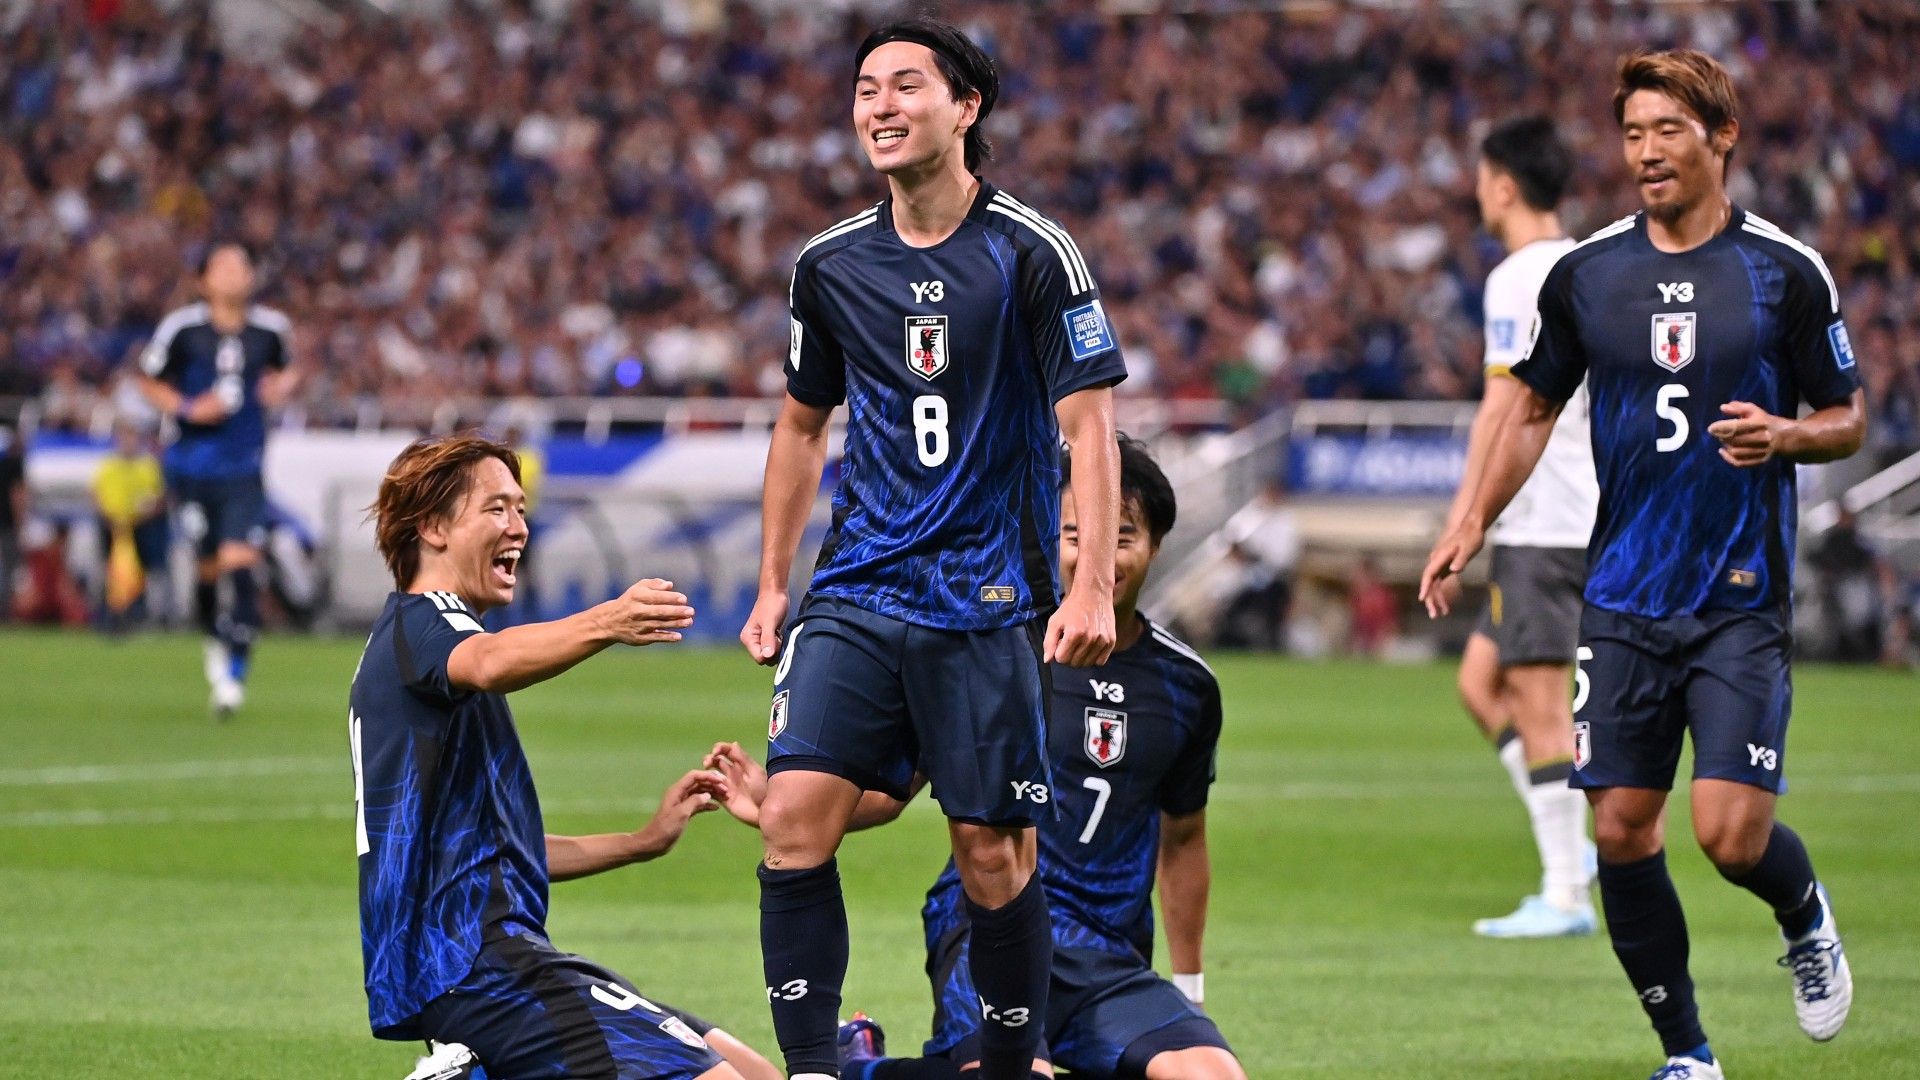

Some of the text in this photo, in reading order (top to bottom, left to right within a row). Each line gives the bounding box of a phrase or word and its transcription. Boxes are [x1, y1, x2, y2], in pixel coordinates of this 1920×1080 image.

[910, 280, 945, 304] Y-3
[1656, 281, 1695, 304] Y-3
[1074, 317, 1100, 333] UNITES
[919, 359, 938, 368] JFA
[912, 395, 949, 467] 8
[1656, 383, 1690, 453] 5
[1089, 678, 1125, 704] Y-3
[1572, 646, 1594, 714] 5
[1746, 742, 1777, 771] Y-3
[1010, 780, 1048, 804] Y-3
[1078, 776, 1112, 845] 7
[590, 982, 663, 1014] 4
